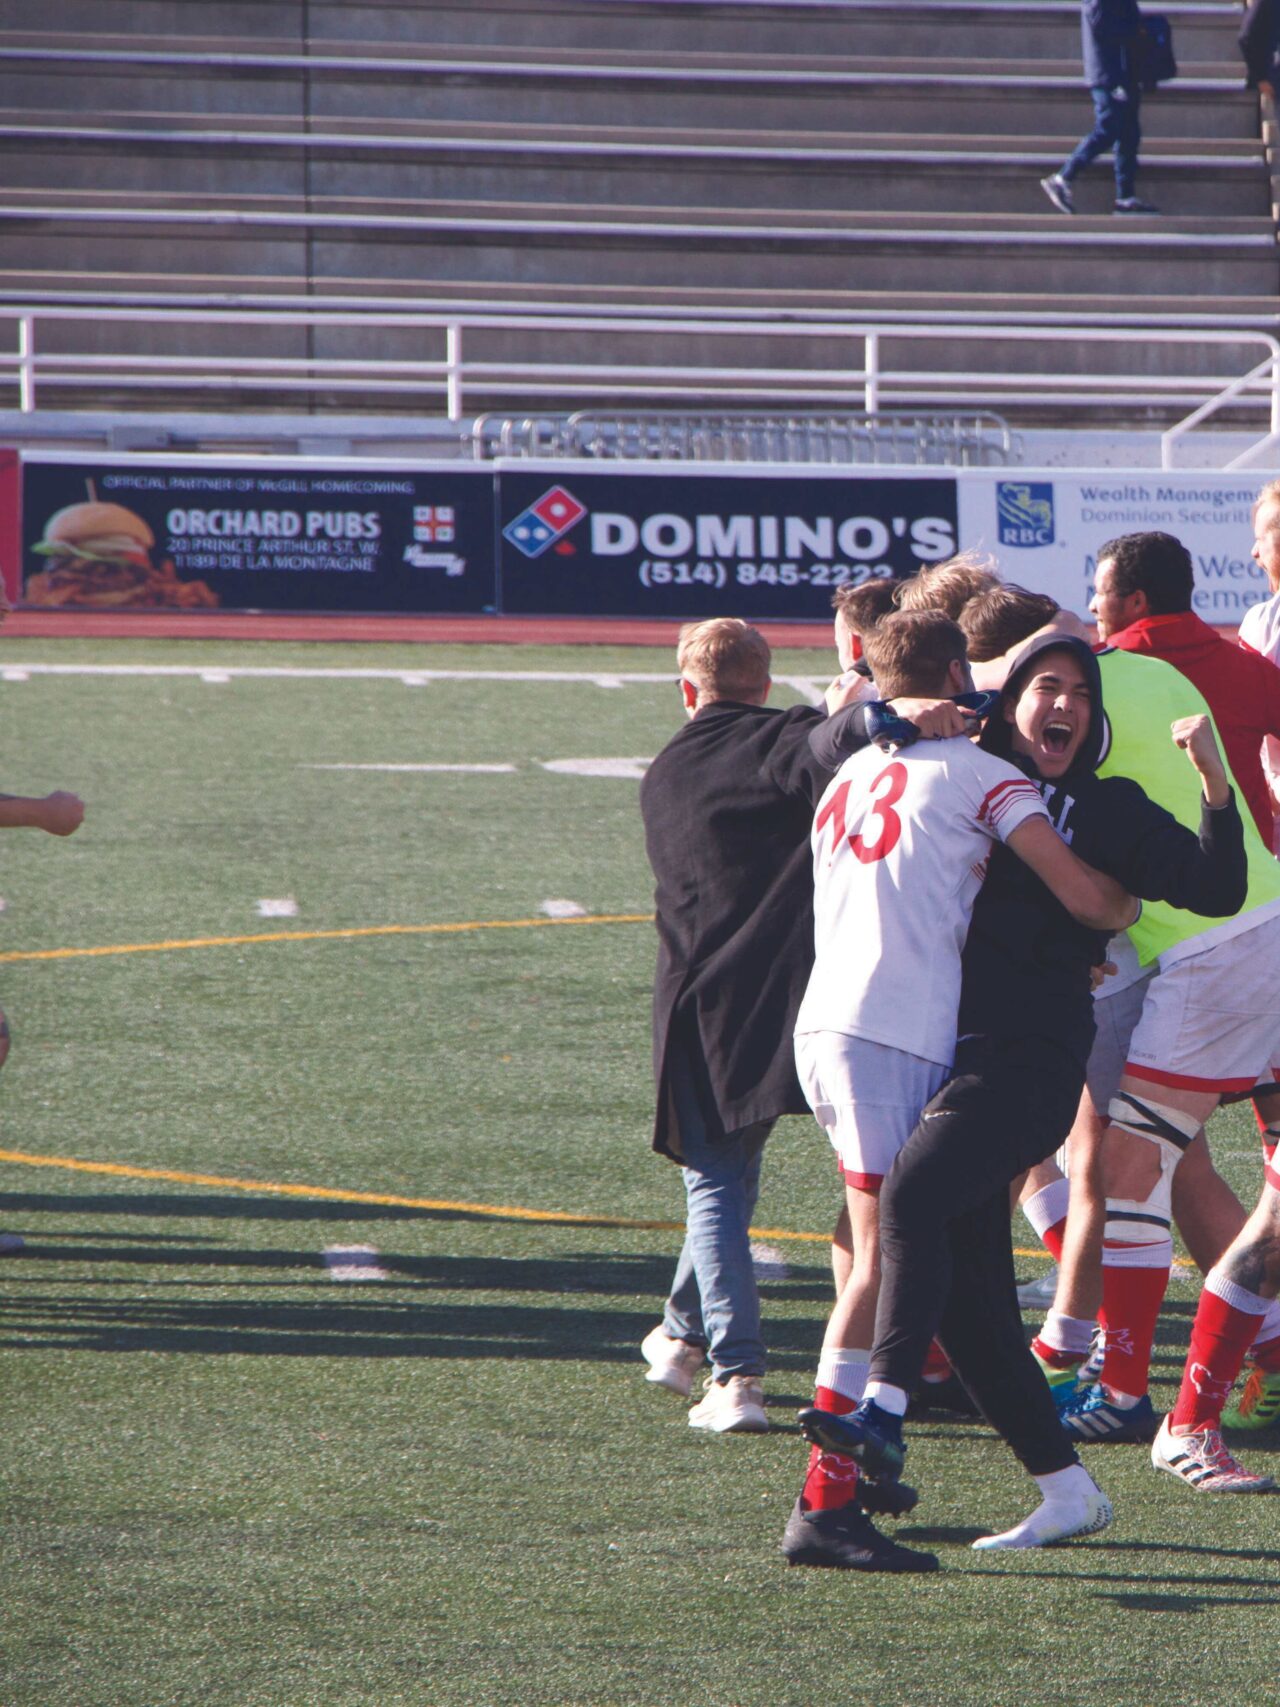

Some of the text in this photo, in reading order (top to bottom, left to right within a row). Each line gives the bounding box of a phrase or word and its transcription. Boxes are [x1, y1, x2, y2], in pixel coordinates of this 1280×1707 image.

[169, 476, 231, 491] PARTNER
[235, 477, 254, 492] OF
[311, 479, 415, 495] HOMECOMING
[1081, 485, 1149, 501] Wealth
[167, 509, 381, 538] ORCHARD PUBS
[1081, 508, 1250, 524] Dominion Securiti
[590, 512, 955, 561] DOMINO'S
[1003, 528, 1050, 545] RBC
[192, 538, 254, 554] PRINCE
[258, 539, 330, 554] ARTHUR
[219, 555, 244, 570] DE
[246, 555, 271, 570] LA
[273, 556, 376, 572] MONTAGNE
[639, 560, 727, 588] (514)
[816, 762, 908, 866] 13
